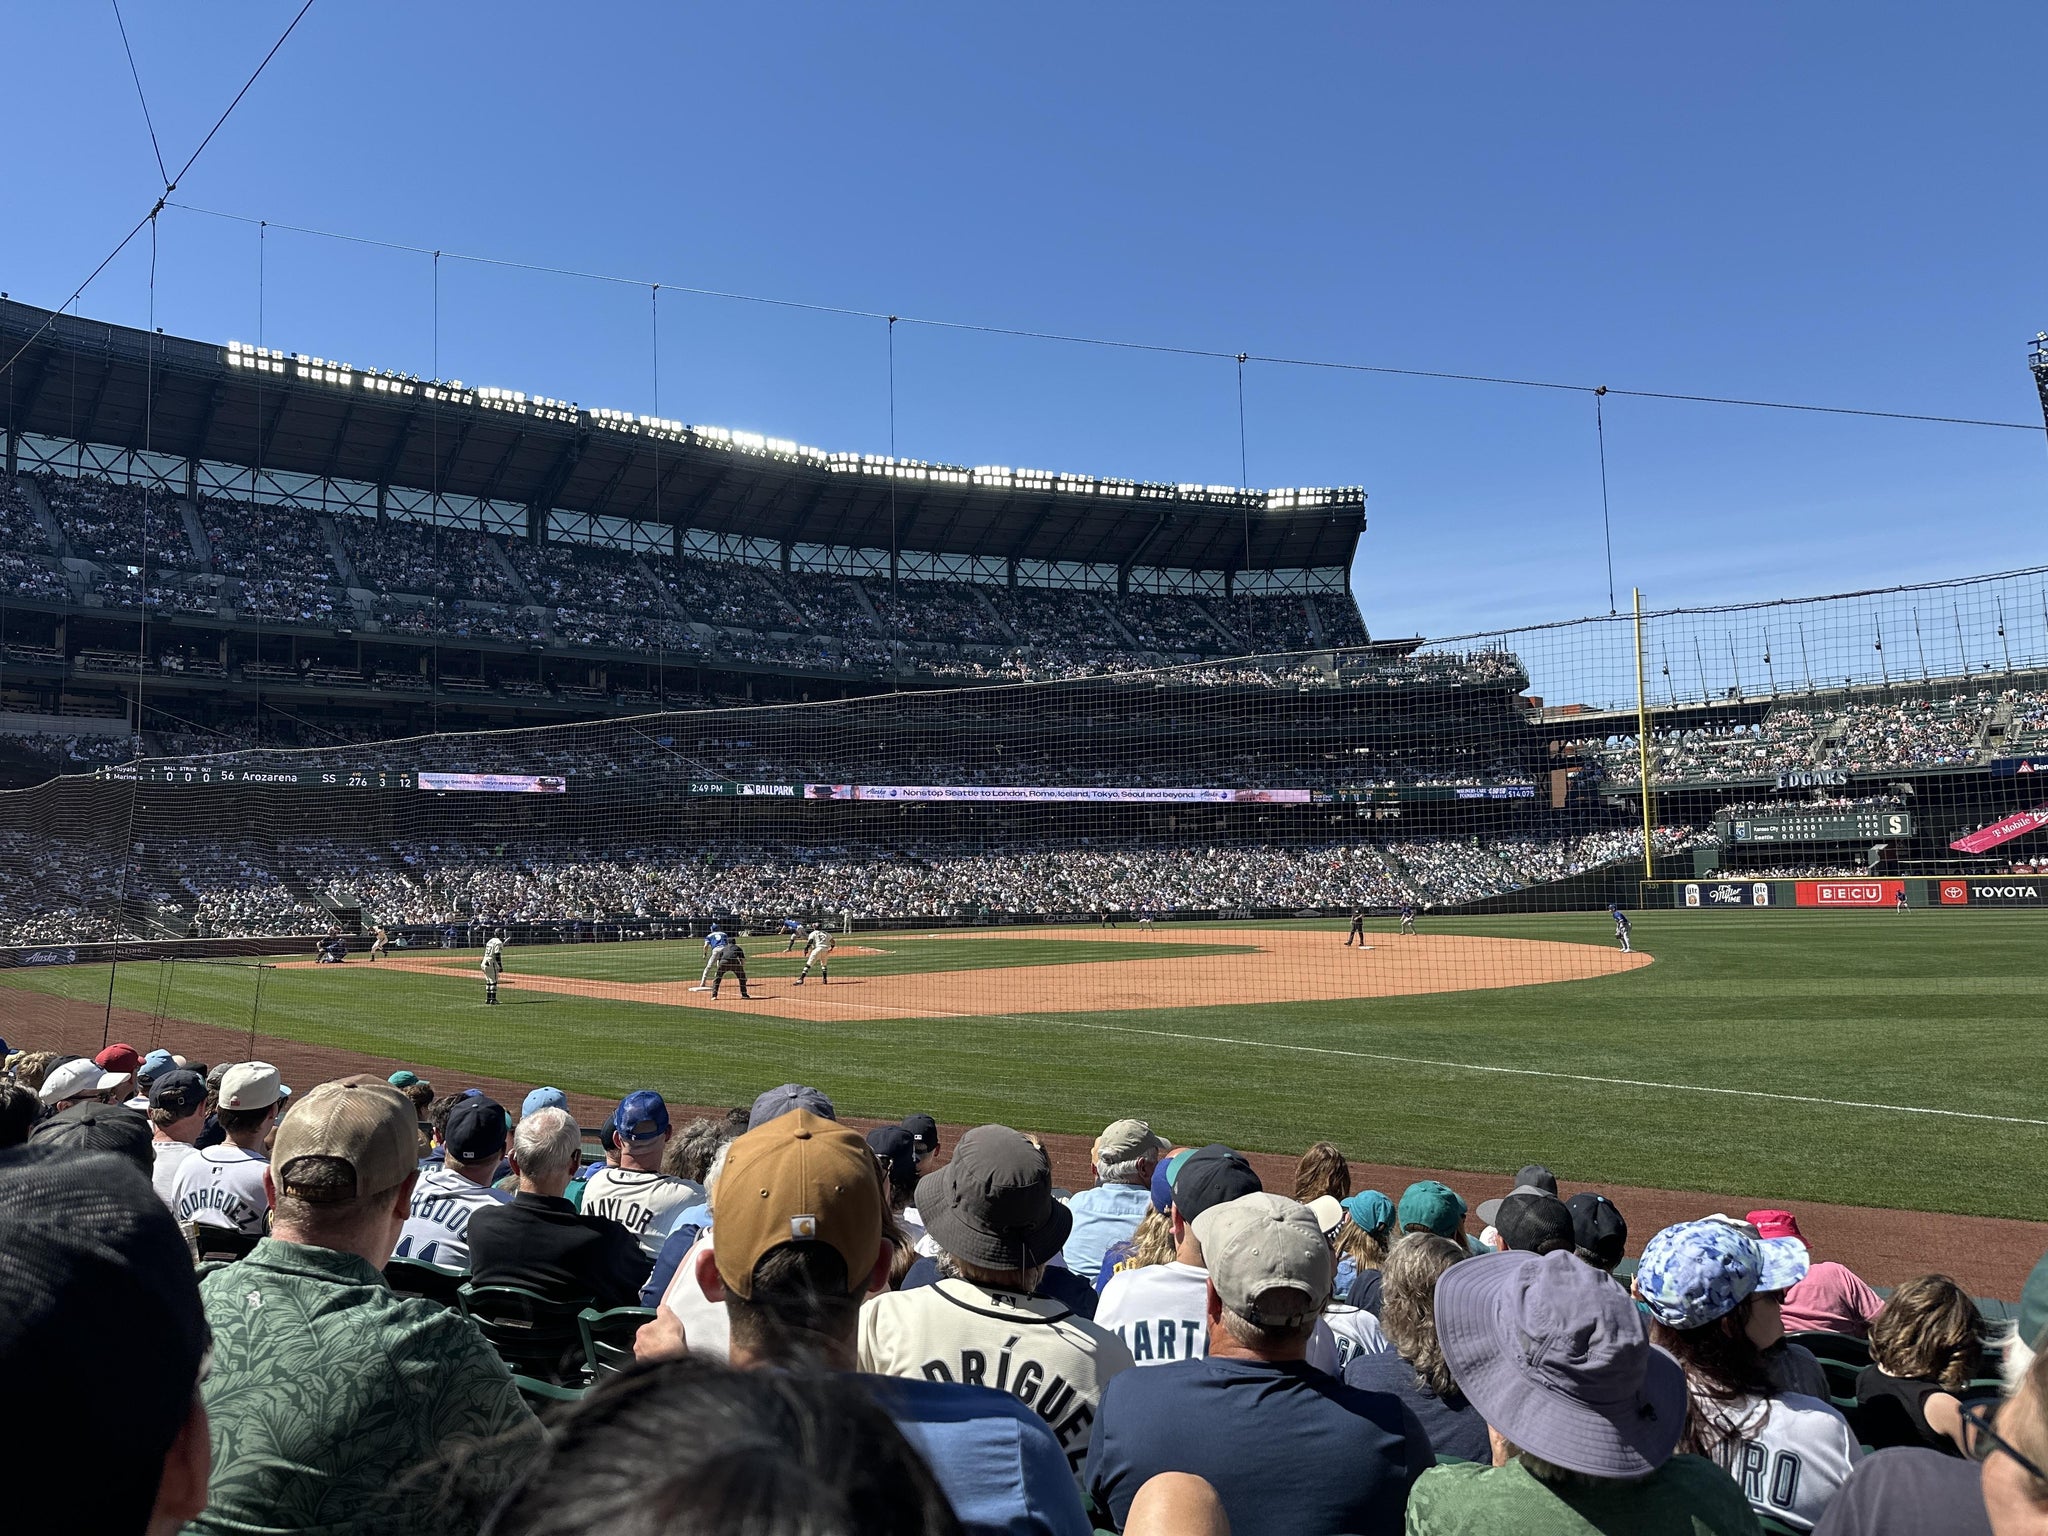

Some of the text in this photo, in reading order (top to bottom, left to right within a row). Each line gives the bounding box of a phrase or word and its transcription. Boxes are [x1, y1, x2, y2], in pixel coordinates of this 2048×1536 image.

[166, 772, 210, 782] 0 0 0
[221, 771, 336, 783] 56 Arozarena SS
[346, 777, 410, 788] .276 3 12
[692, 784, 708, 792] 2:49
[756, 785, 794, 795] BALLPARK
[903, 789, 943, 797] Nonstop
[1890, 816, 1902, 834] S
[2001, 818, 2030, 835] Mobile
[1710, 886, 1742, 902] Miller
[1823, 888, 1877, 898] BECU
[1972, 887, 2037, 898] TOYOTA
[1217, 909, 1254, 919] STIHL
[25, 952, 57, 962] Alaska
[180, 1180, 260, 1230] ODRÍGUEZ
[587, 1198, 654, 1234] NAYLOR
[1113, 1320, 1209, 1361] ART
